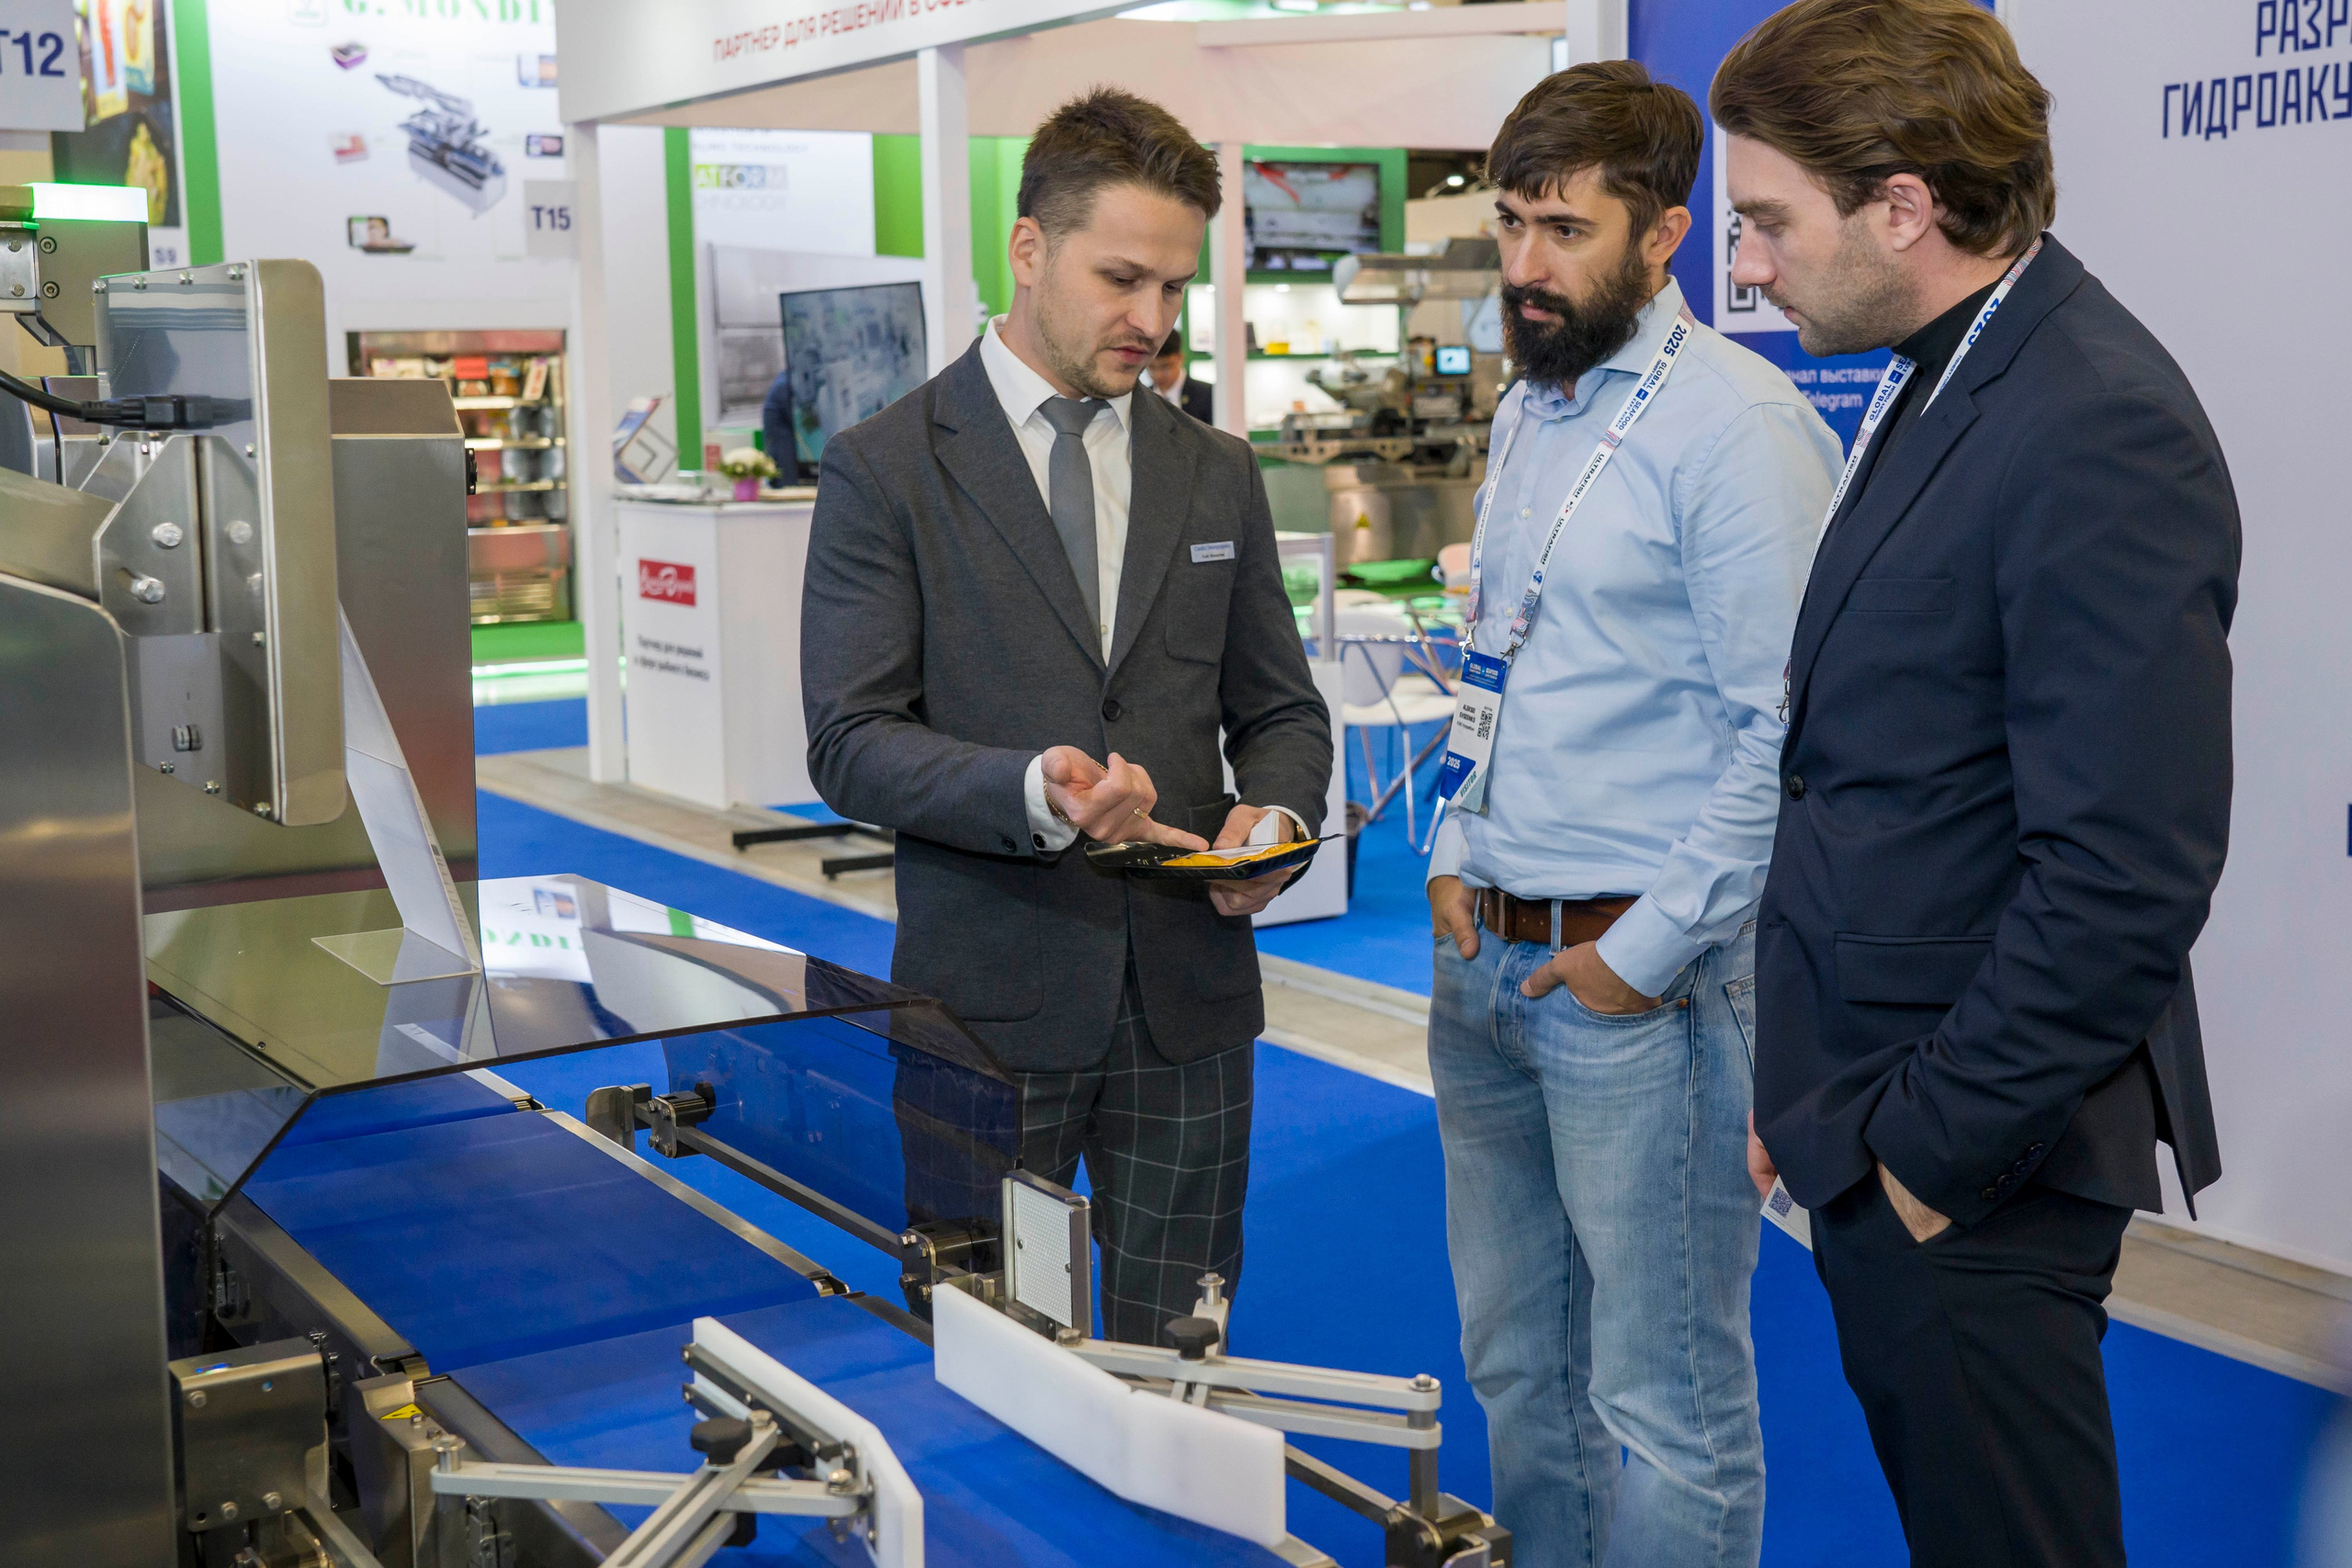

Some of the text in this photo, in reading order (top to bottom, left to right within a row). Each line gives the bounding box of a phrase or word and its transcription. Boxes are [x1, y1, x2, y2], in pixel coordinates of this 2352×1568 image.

[713, 25, 779, 62] ПАРТНЕР
[784, 17, 817, 50] ДЛЯ
[2256, 0, 2352, 57] РАЗР
[2163, 61, 2352, 141] ГИДРОАКУ
[529, 205, 571, 231] T15
[1663, 324, 1688, 357] 2025
[1645, 361, 1668, 389] GLOBAL
[1618, 400, 1642, 431] SEAFOOD
[1869, 384, 1893, 421] GLOBAL
[1574, 453, 1605, 499] ULTRAFISH
[1832, 455, 1858, 513] ULTRAFISH
[1541, 517, 1565, 565] ULTRAFISH
[1447, 756, 1461, 770] 2025
[1459, 771, 1477, 798] VISITOR
